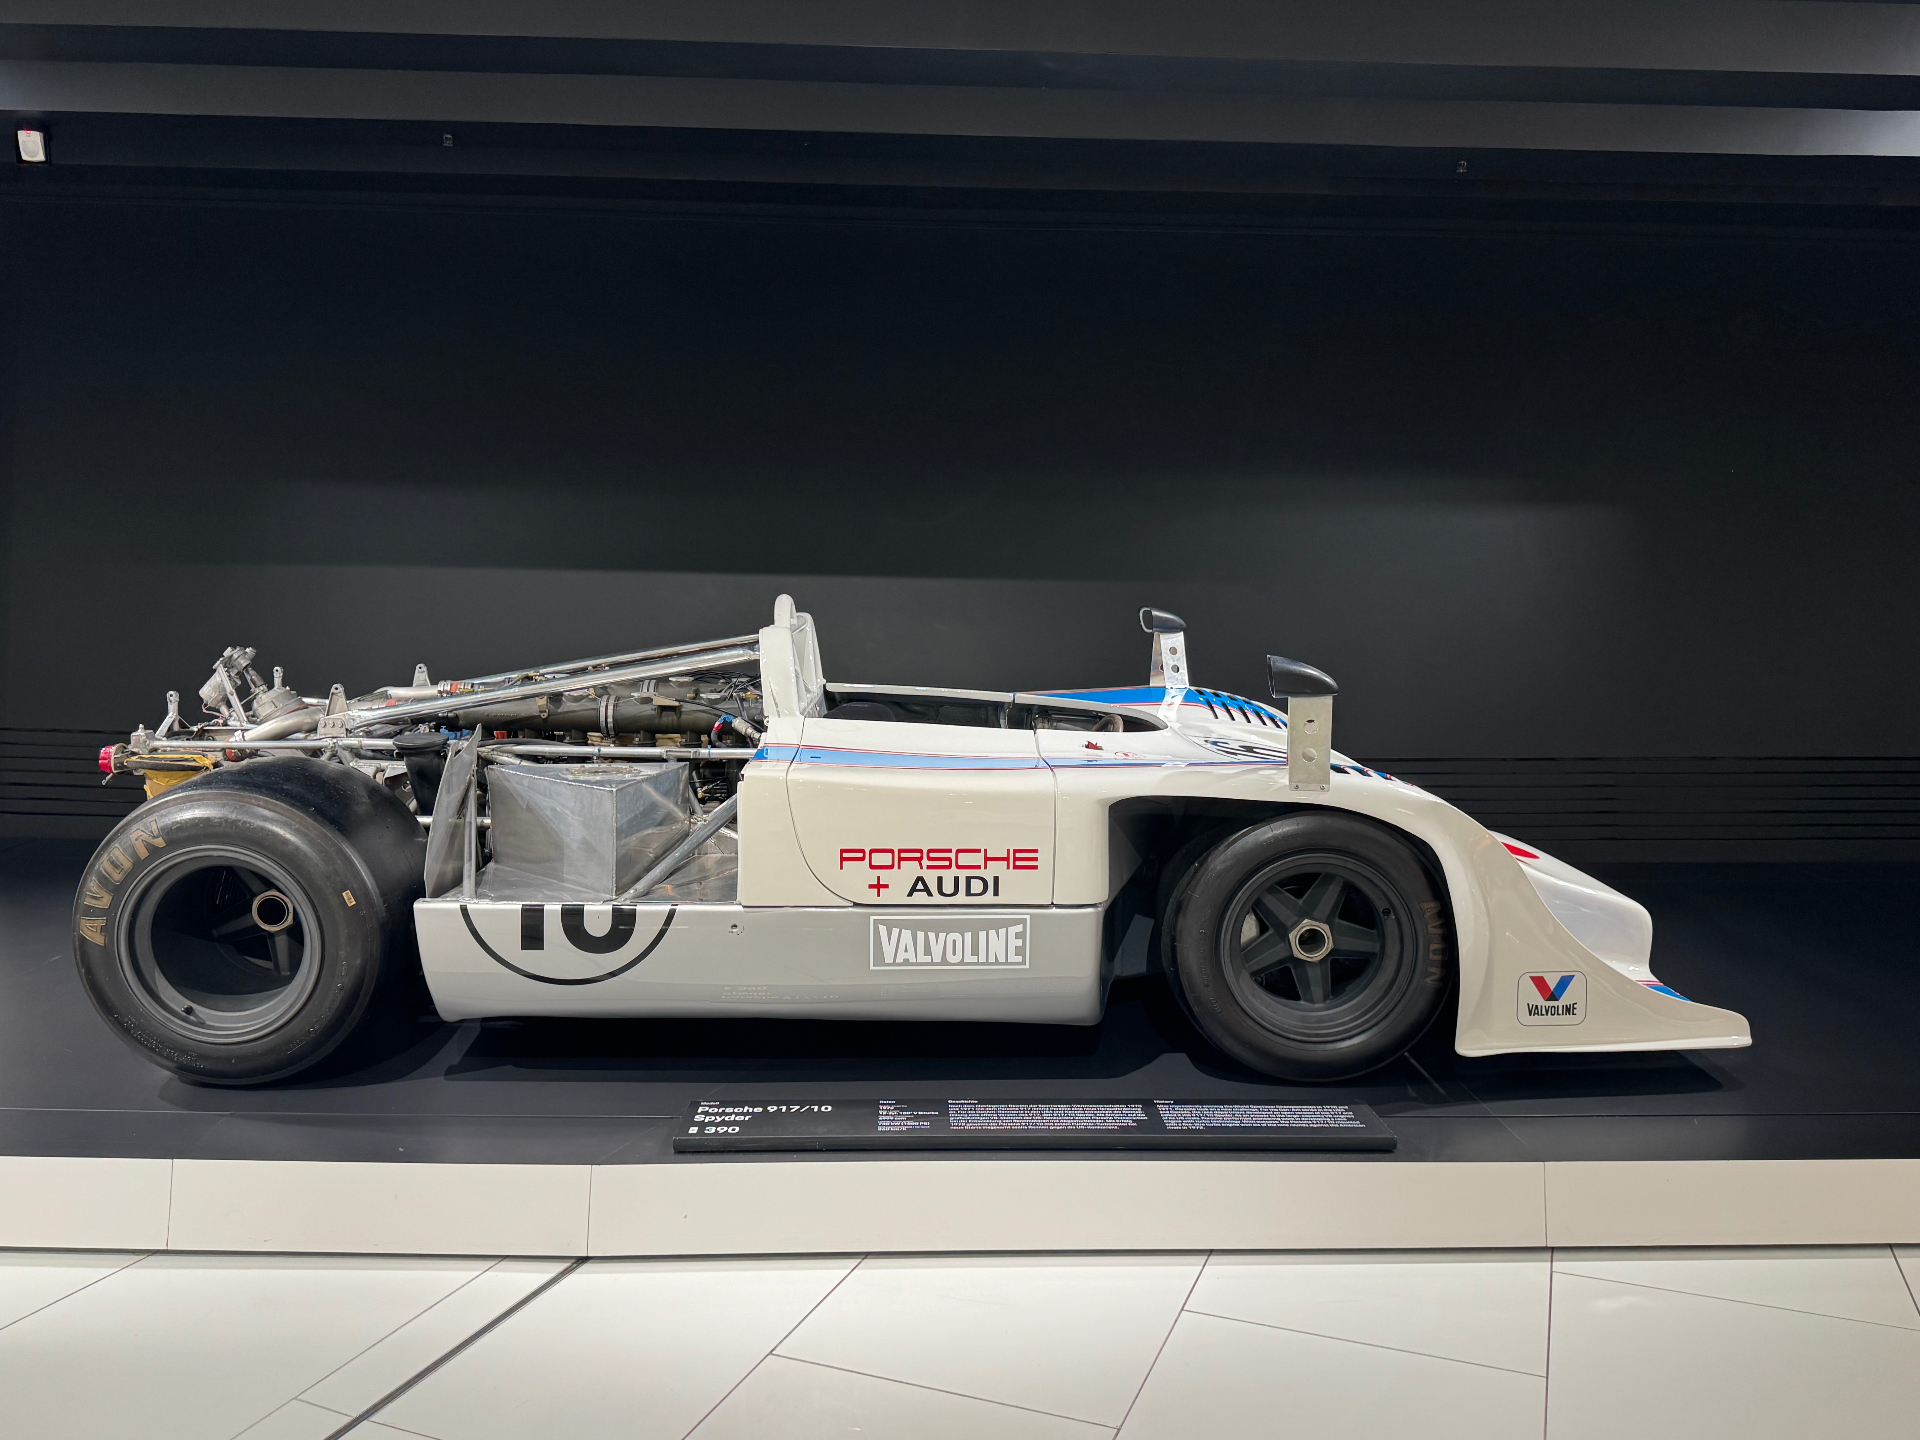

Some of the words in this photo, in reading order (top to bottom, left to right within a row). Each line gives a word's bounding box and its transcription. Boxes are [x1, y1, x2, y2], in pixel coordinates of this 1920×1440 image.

[839, 848, 1039, 870] PORSCHE
[79, 819, 167, 947] AVON
[906, 875, 1000, 898] AUDI
[877, 923, 1024, 964] VALVOLINE
[1526, 1002, 1578, 1017] VALVOLINE
[693, 1113, 753, 1123] Spyder
[697, 1105, 763, 1113] Porsche
[766, 1105, 833, 1113] 917/10
[704, 1126, 740, 1134] 390
